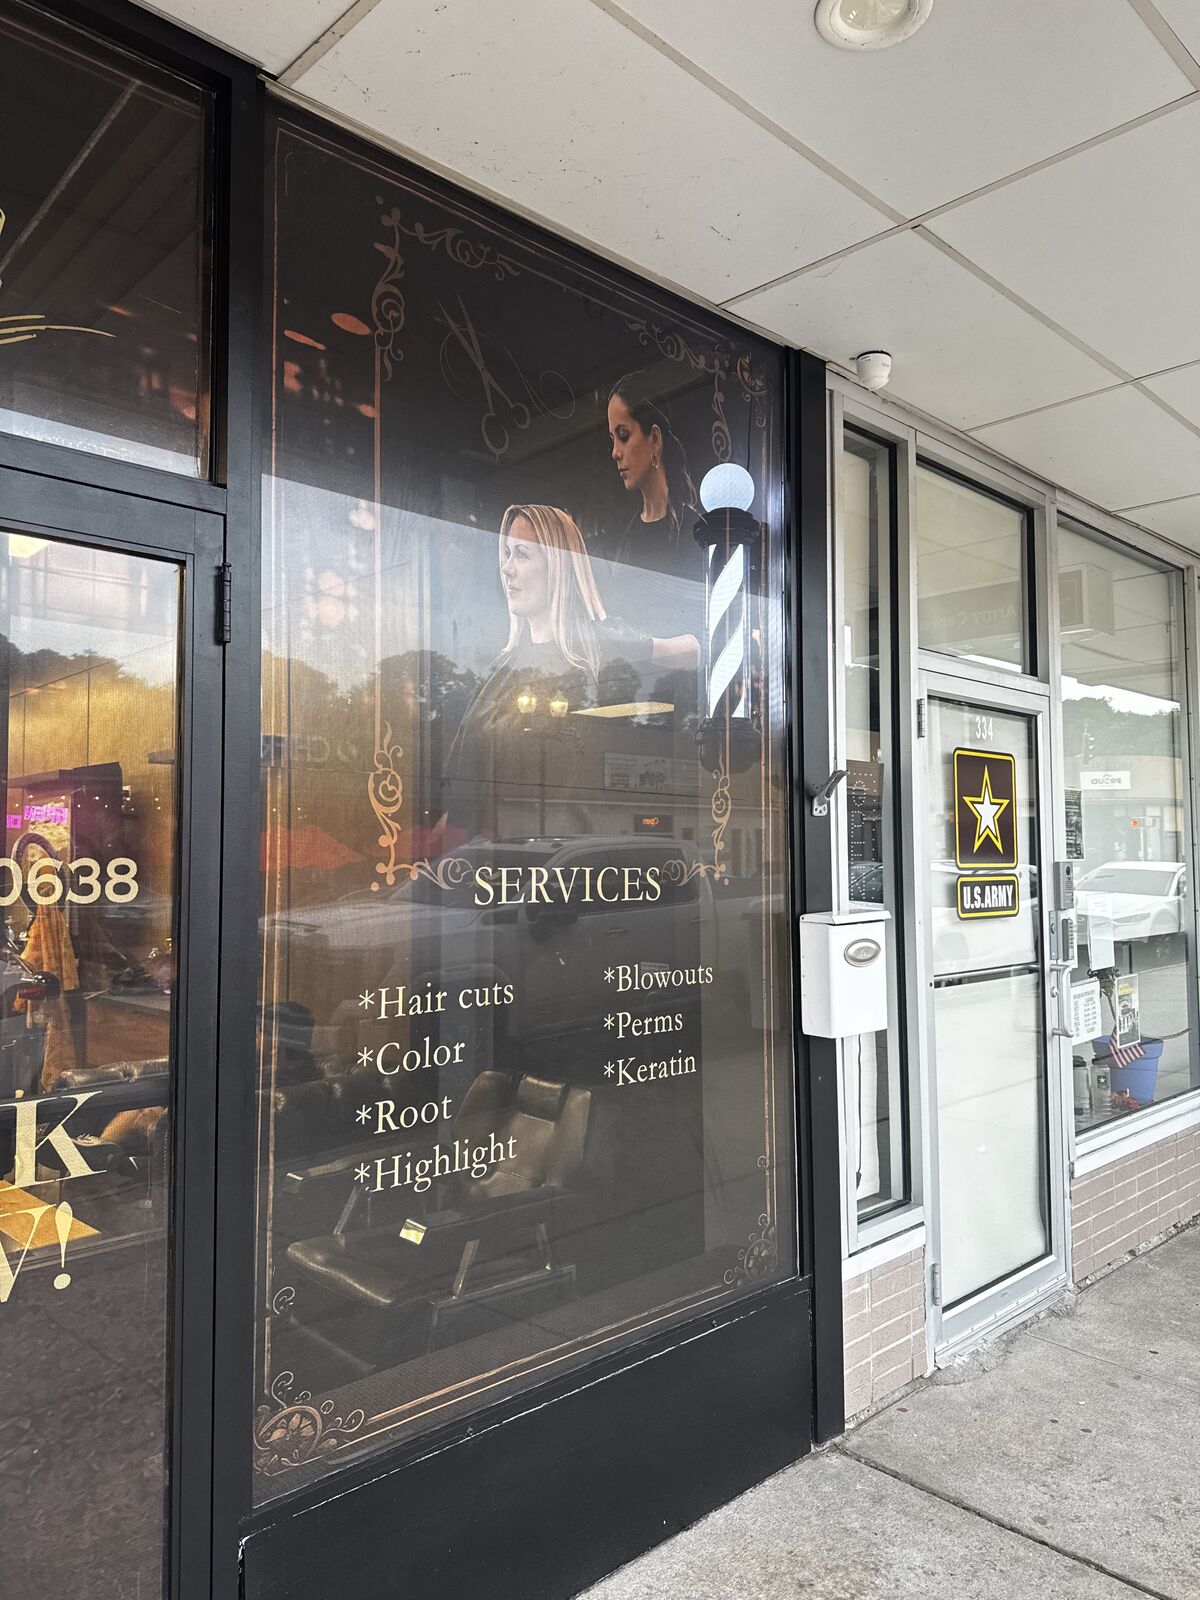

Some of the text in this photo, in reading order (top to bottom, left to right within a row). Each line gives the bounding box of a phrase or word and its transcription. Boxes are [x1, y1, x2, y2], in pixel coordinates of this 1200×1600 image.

[975, 715, 994, 741] 334
[851, 780, 866, 900] OPEN
[0, 857, 139, 906] 0638
[474, 866, 662, 906] SERVICES
[458, 982, 515, 1009] cuts
